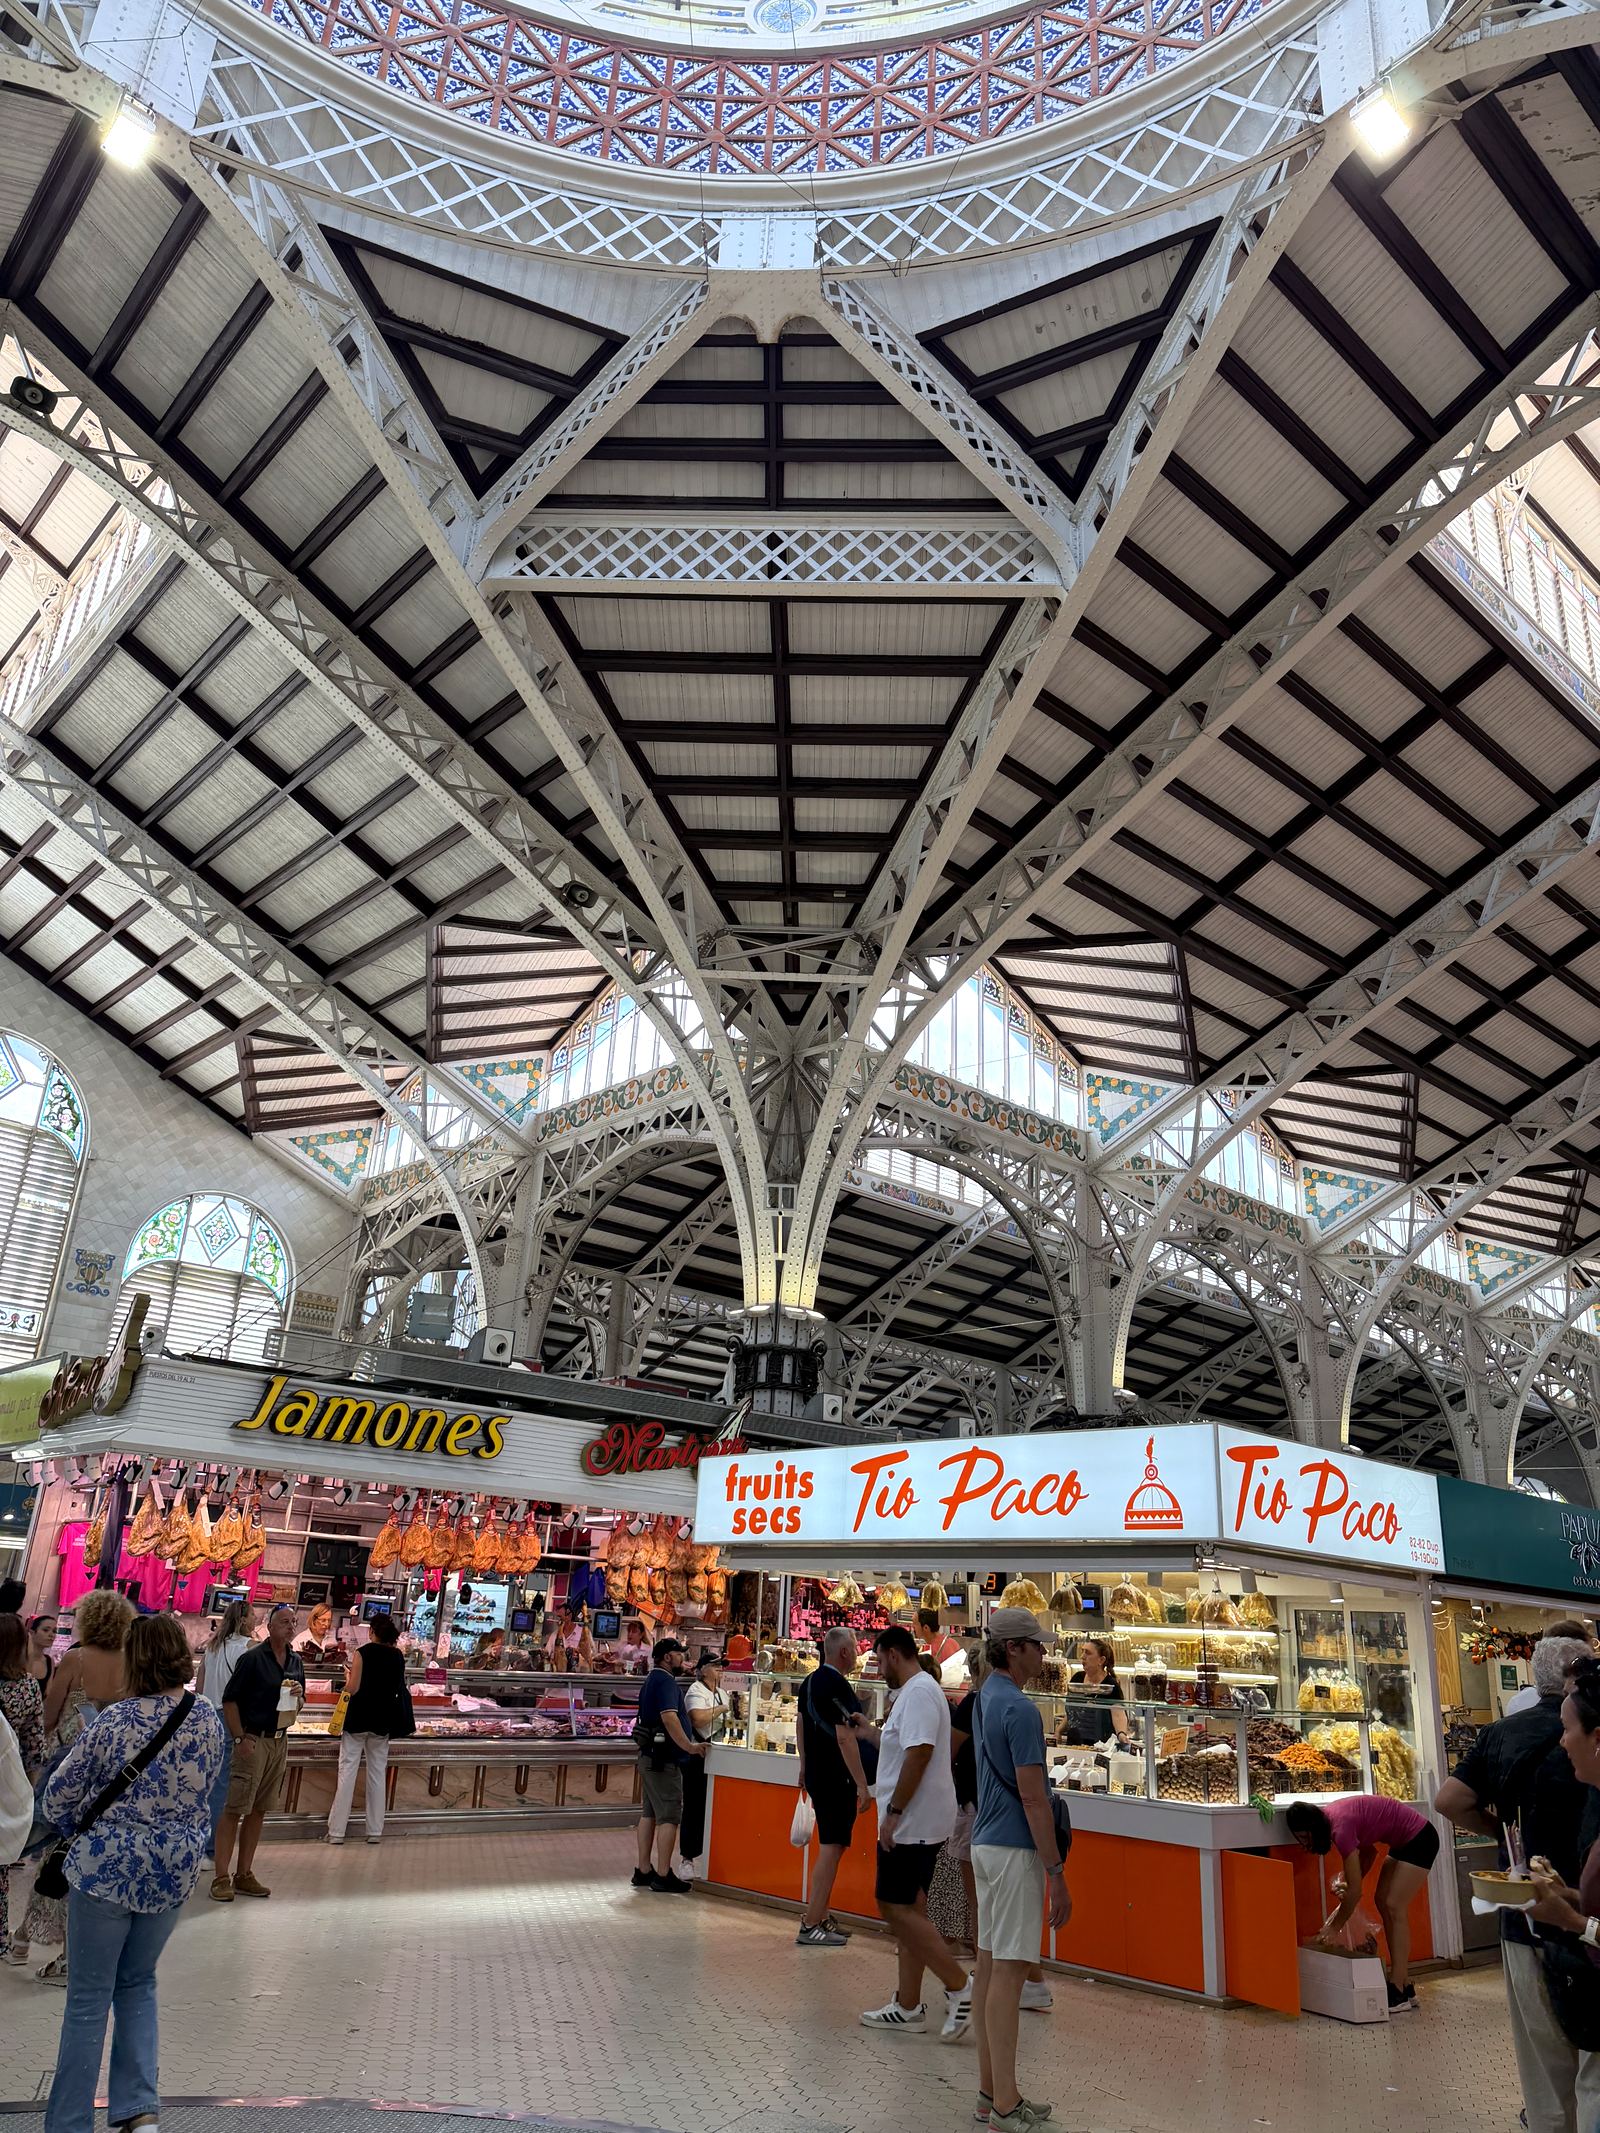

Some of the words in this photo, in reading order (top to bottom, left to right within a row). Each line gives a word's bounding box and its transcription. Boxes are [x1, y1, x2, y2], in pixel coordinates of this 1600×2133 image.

[235, 1375, 511, 1460] Jamones
[726, 1460, 814, 1502] fruits
[732, 1505, 801, 1535] secs
[851, 1449, 920, 1533] Tio
[938, 1445, 1088, 1531] Paco
[1227, 1445, 1292, 1532] Tio
[1299, 1459, 1403, 1544] Paco
